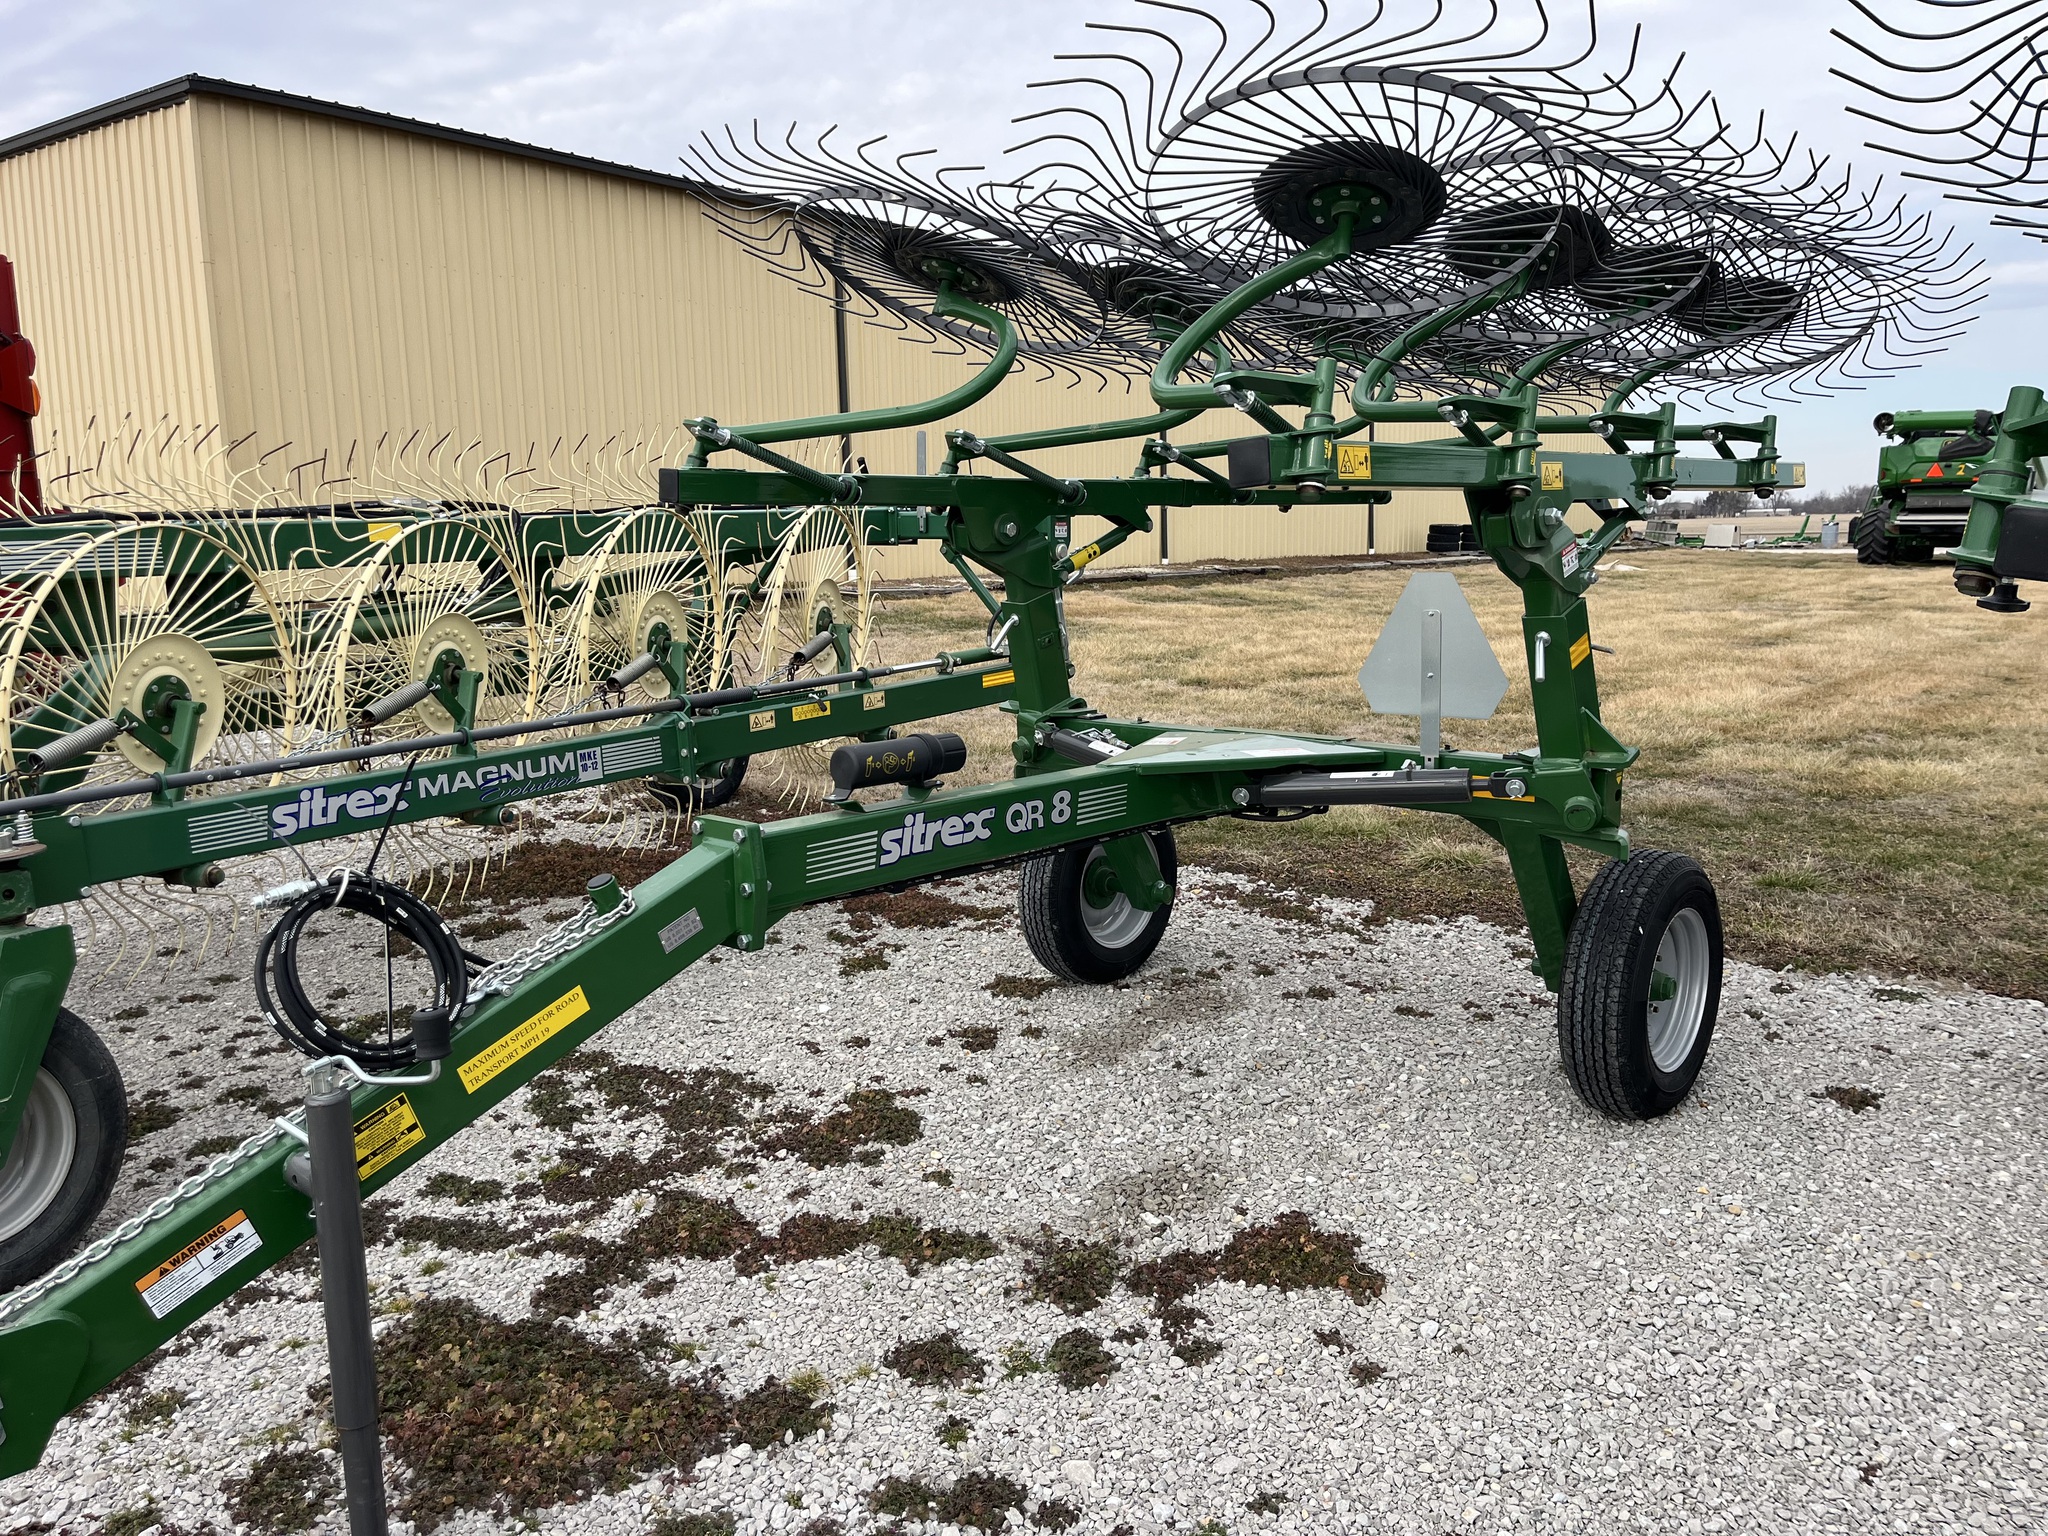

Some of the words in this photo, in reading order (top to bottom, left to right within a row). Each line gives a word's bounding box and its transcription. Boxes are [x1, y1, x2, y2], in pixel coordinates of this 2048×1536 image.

[579, 750, 598, 762] MKE
[580, 761, 599, 773] 10-12
[271, 780, 412, 839] sitrex
[418, 751, 576, 799] MAGNUM
[479, 774, 582, 802] Evolution
[879, 807, 996, 866] sitrex
[1006, 800, 1044, 833] QR
[1051, 790, 1072, 824] 8
[463, 1041, 510, 1076] MAXIMUM
[510, 1022, 537, 1044] SPEED
[537, 1009, 555, 1025] FOR
[555, 992, 580, 1012] ROAD
[468, 1048, 519, 1087] TRANSPORT
[520, 1035, 540, 1052] MPH
[541, 1027, 550, 1037] 19
[360, 1111, 386, 1130] WARNING
[169, 1225, 227, 1267] WARNING
